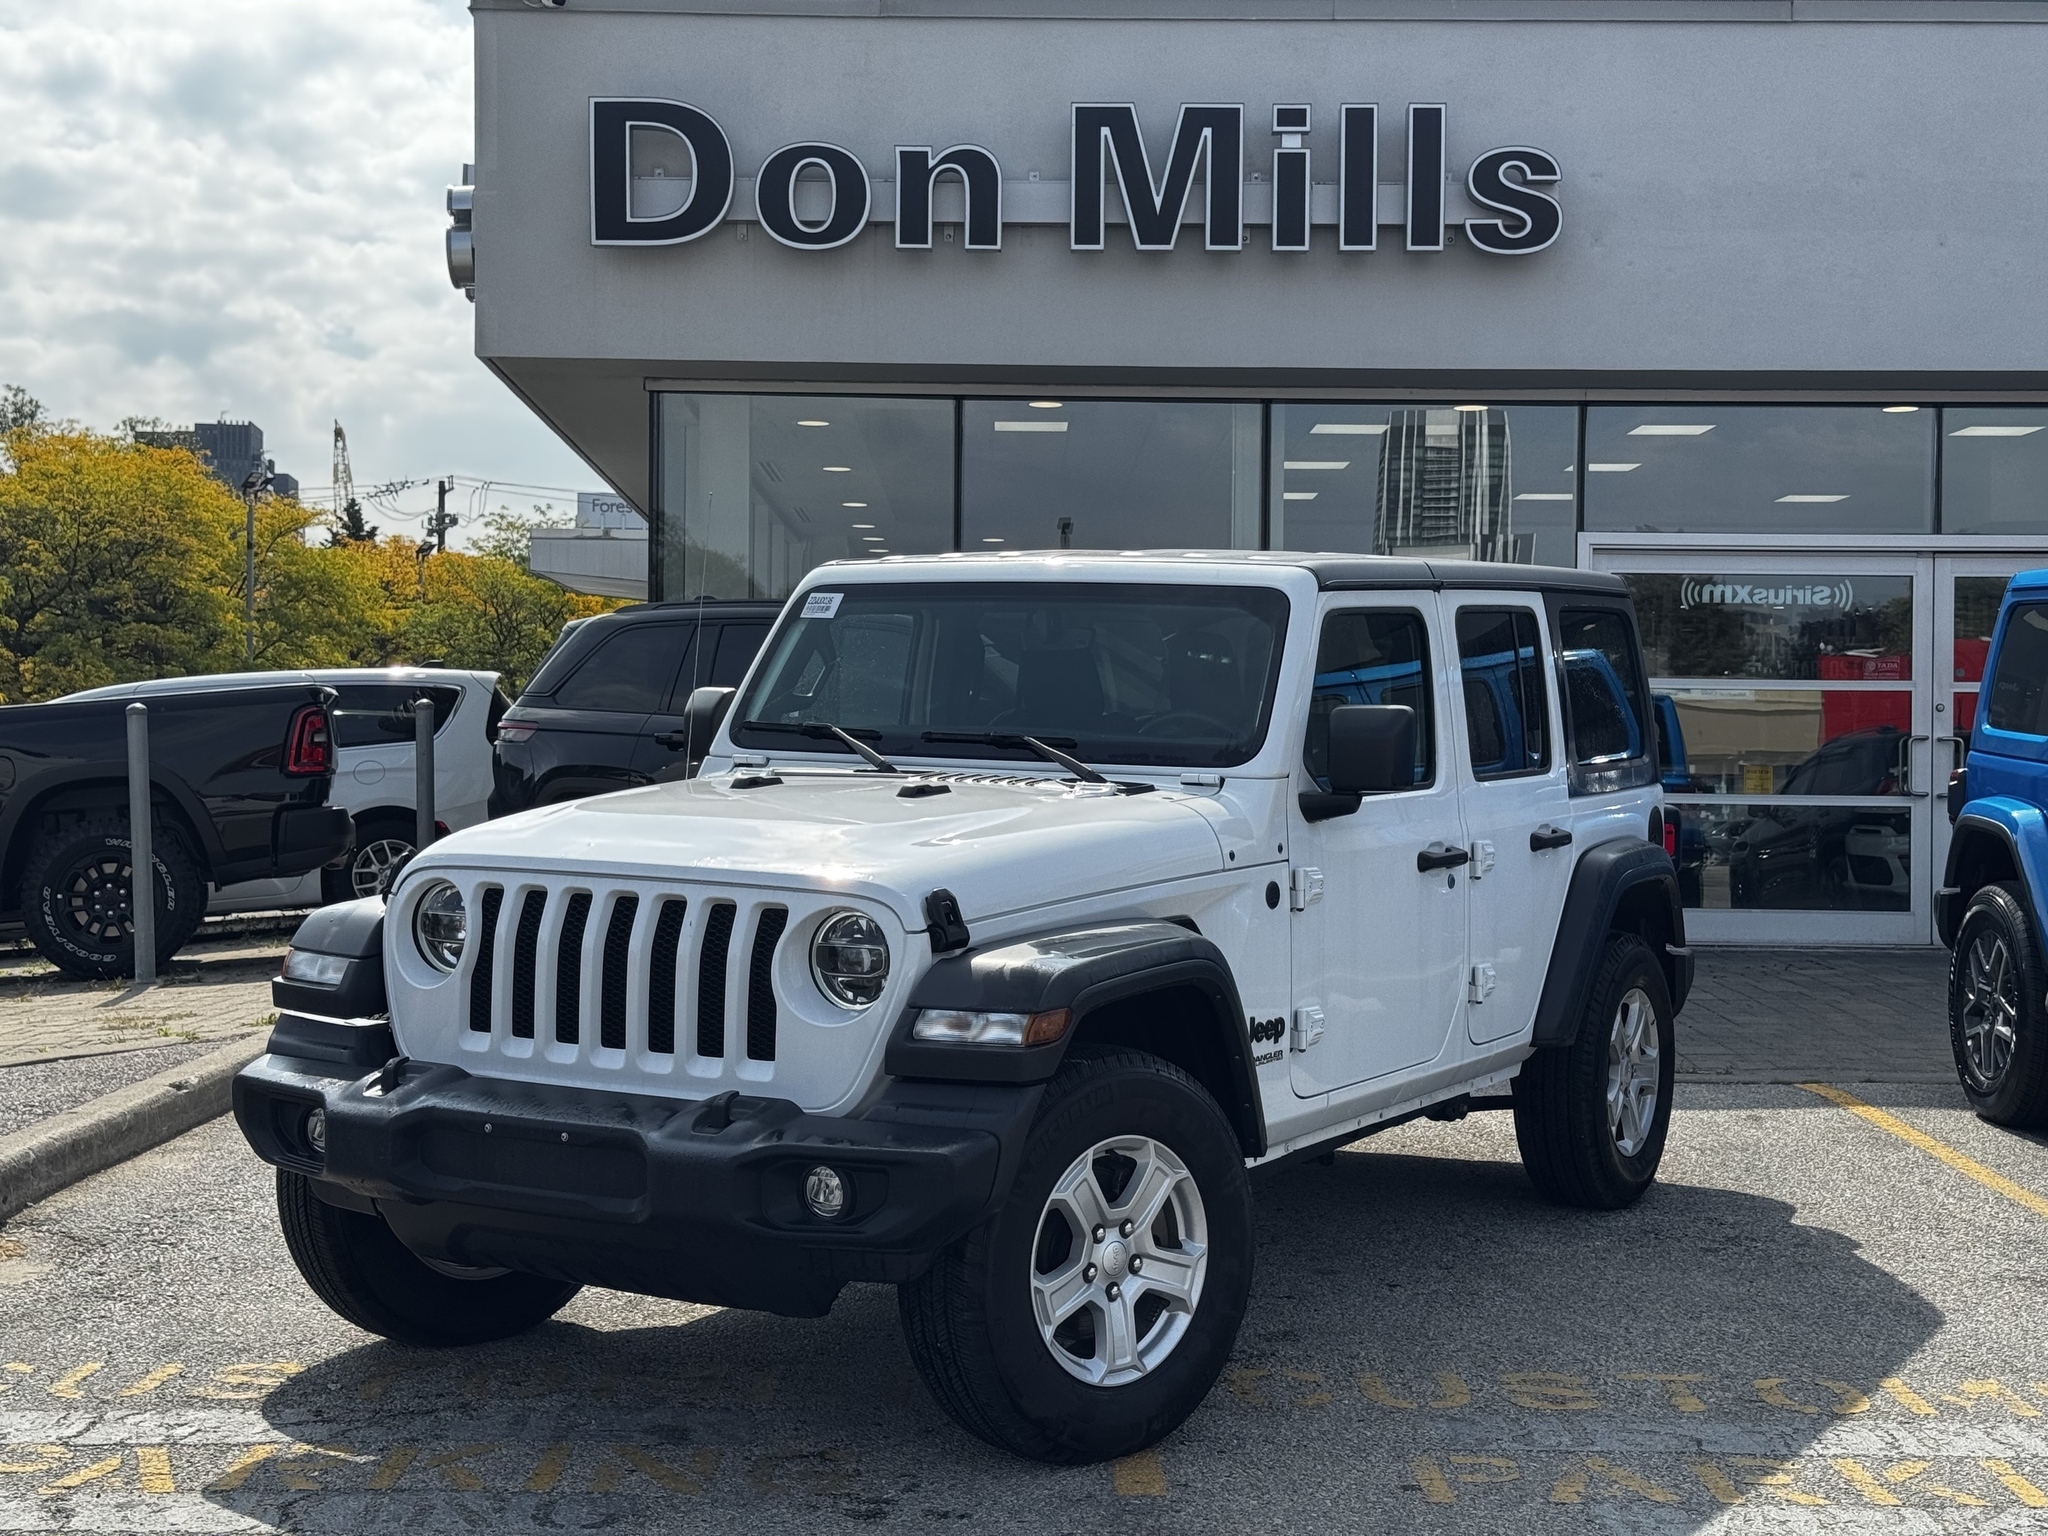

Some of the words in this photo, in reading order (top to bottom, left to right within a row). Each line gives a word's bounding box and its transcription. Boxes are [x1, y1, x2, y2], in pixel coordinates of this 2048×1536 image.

[588, 95, 1003, 252] Don
[1070, 100, 1564, 255] Mills
[592, 498, 633, 514] Fores
[105, 837, 176, 911] WRNGLER
[42, 885, 117, 962] GOODYEAR
[1249, 1016, 1286, 1045] Jeep
[1254, 1049, 1284, 1062] ANGLER
[1228, 1365, 2048, 1419] CUSTOM
[1408, 1451, 2048, 1509] PARKI
